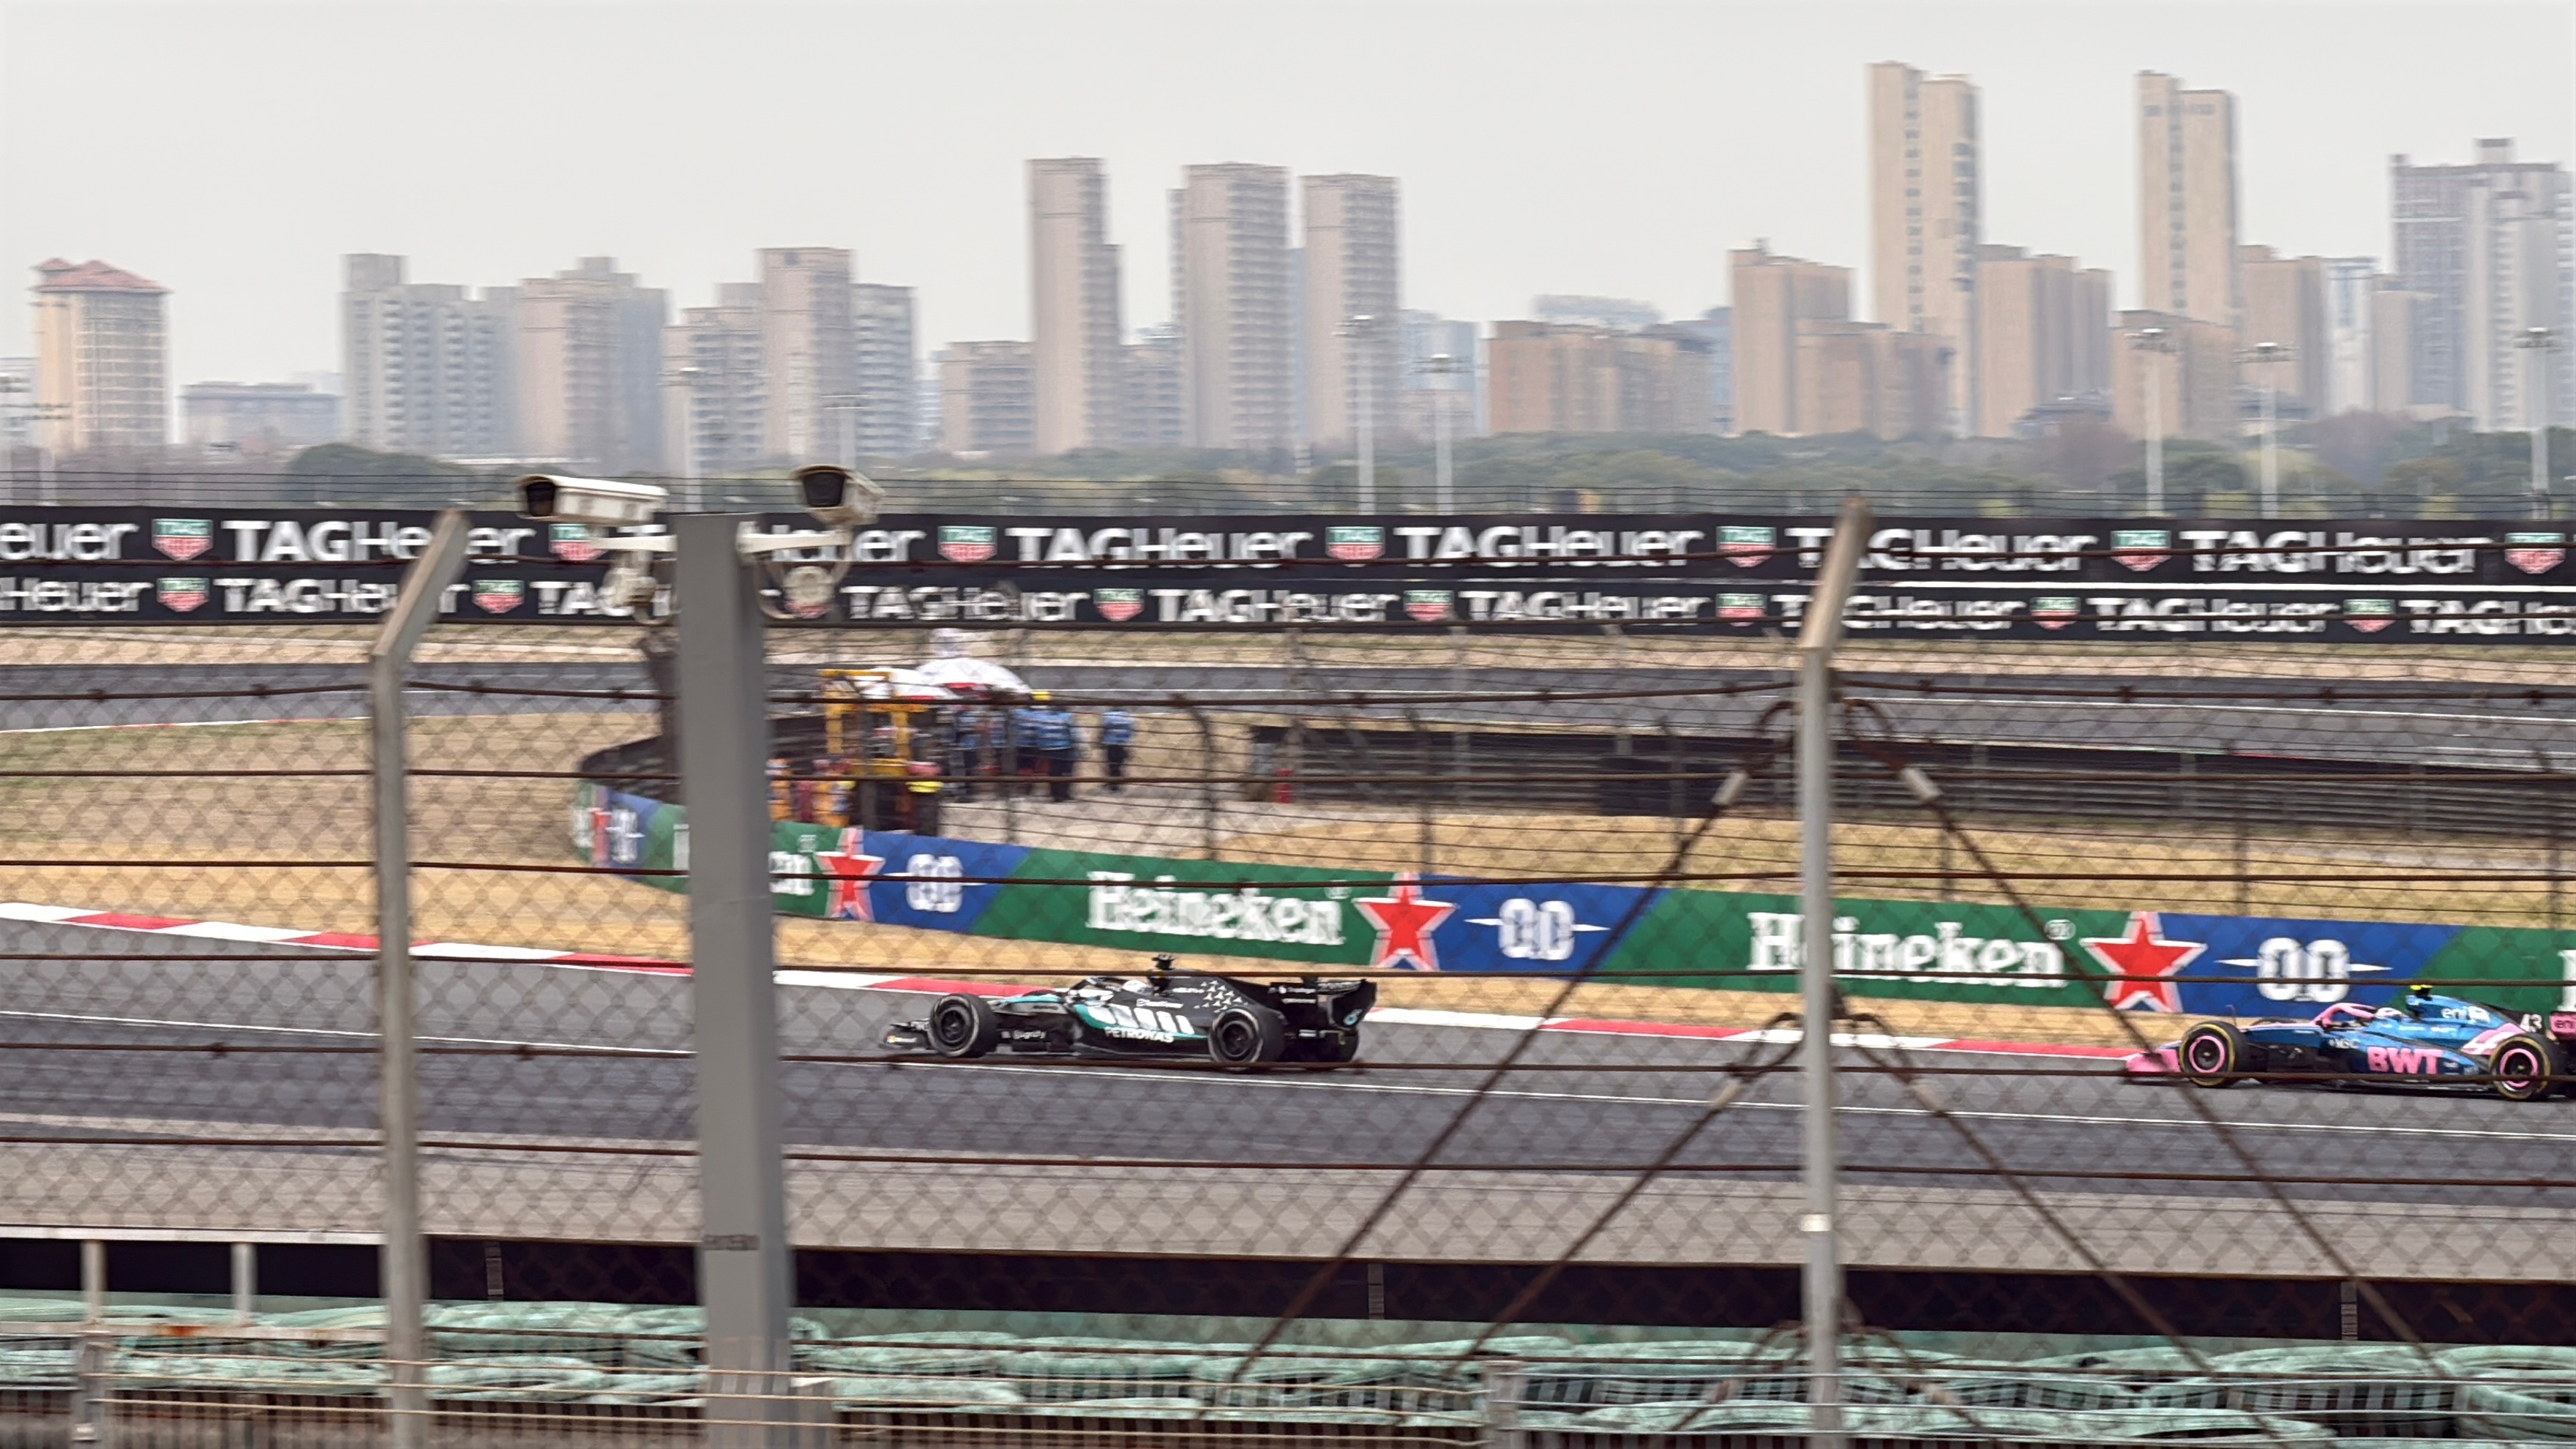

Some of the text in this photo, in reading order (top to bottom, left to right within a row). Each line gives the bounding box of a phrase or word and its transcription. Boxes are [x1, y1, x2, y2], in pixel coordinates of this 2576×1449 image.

[221, 520, 536, 564] TAGHeer
[1784, 528, 2099, 572] TGHeuer
[1770, 594, 2027, 629] TGHeuer
[1085, 871, 1347, 946] Heineken
[1746, 912, 2069, 988] Hineken
[1104, 1027, 1175, 1043] PETRONAS
[2518, 1014, 2542, 1033] 43
[2367, 1046, 2444, 1075] BWT
